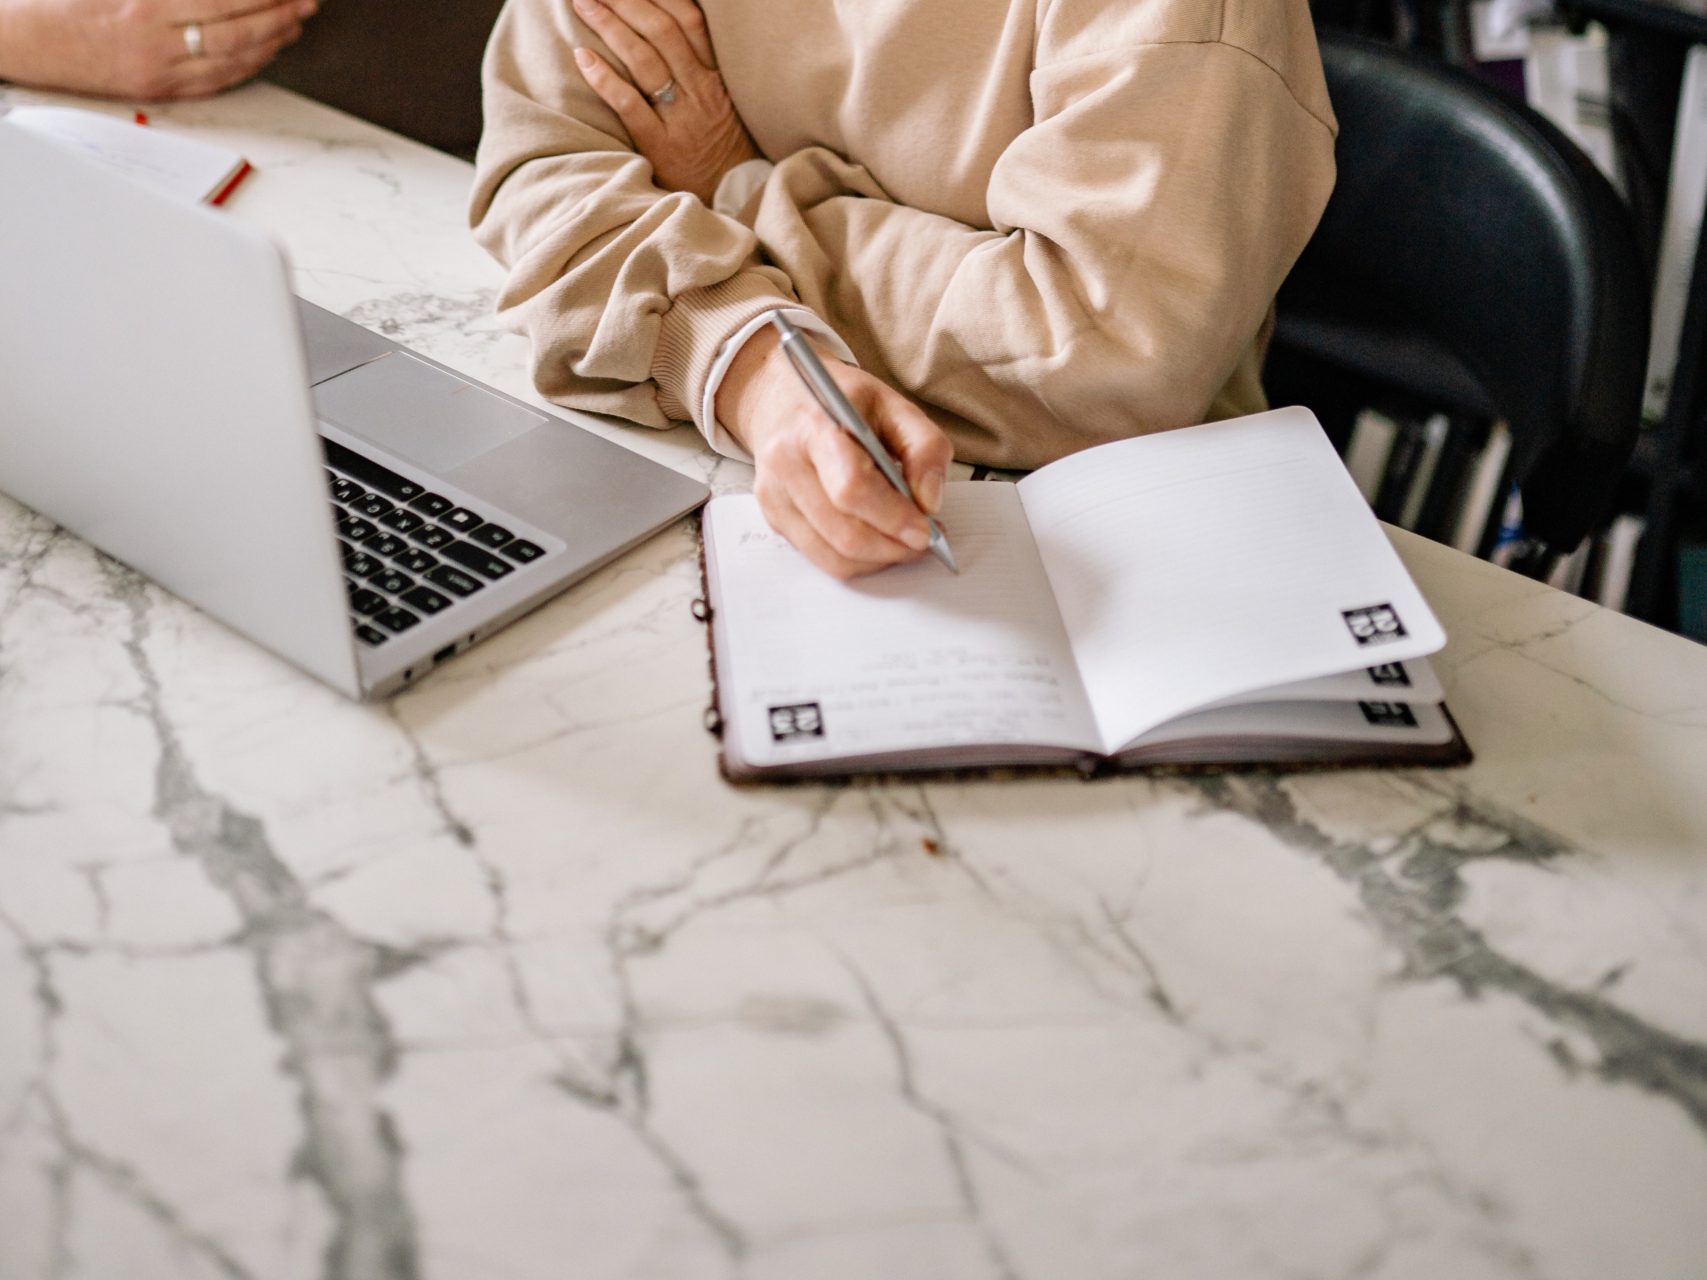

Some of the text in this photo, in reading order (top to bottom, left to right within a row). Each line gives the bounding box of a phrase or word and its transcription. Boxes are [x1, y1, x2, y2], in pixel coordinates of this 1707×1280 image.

[337, 490, 350, 499] V
[396, 519, 411, 529] X
[412, 559, 425, 569] A
[1349, 609, 1399, 637] 22
[771, 707, 819, 734] 23
